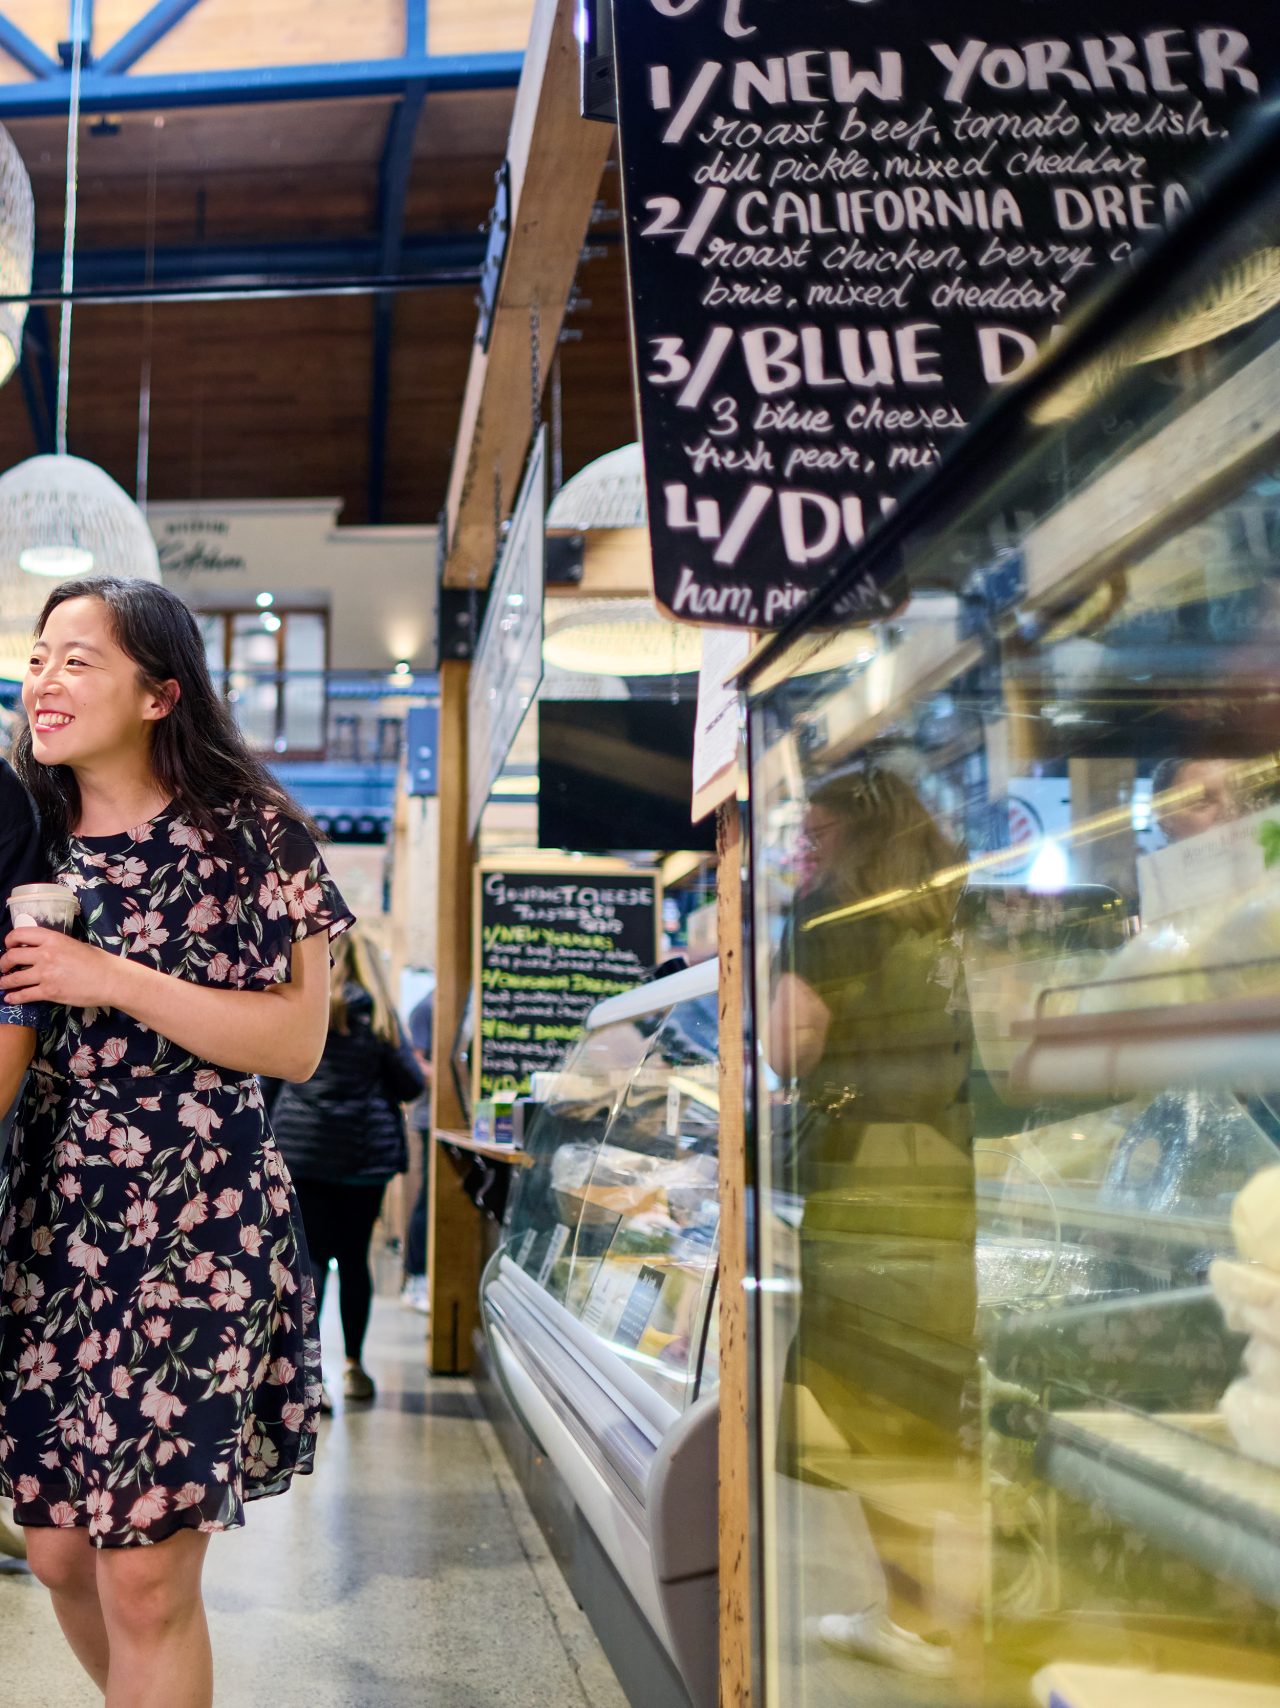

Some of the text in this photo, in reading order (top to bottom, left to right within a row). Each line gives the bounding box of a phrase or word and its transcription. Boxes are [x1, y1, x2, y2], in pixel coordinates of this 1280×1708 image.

[930, 29, 1260, 102] YORKER
[699, 109, 829, 148] roast
[954, 99, 1080, 140] tomato
[694, 150, 763, 185] dill
[885, 141, 992, 180] mixed
[1006, 142, 1147, 178] cheddar
[1054, 182, 1196, 231] DREA
[701, 237, 813, 269] roast
[978, 236, 1096, 284] berry
[807, 273, 912, 307] mixed
[931, 276, 1066, 313] cheddar
[708, 397, 971, 435] 3 blue cheeses
[683, 437, 775, 475] fresh
